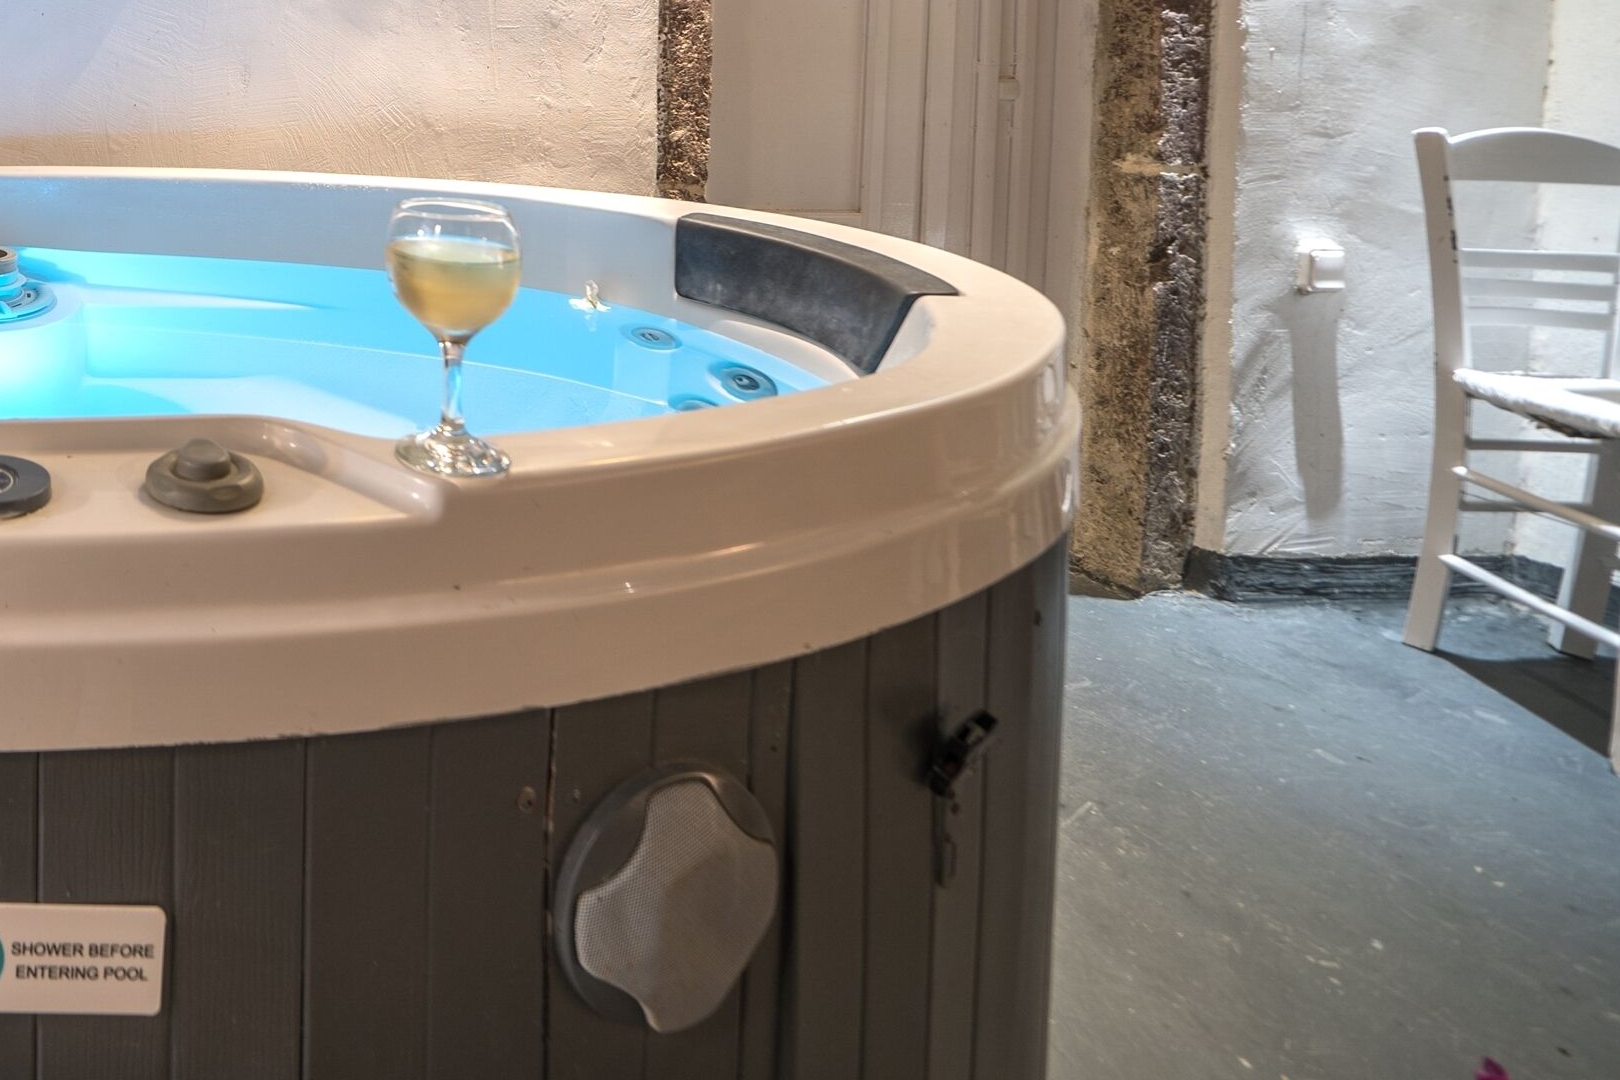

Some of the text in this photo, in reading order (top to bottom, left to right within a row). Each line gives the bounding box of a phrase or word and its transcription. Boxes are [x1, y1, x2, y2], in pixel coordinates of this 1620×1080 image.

[11, 942, 155, 959] SHOWER BEFORE
[15, 965, 148, 981] ENTERING POOL
